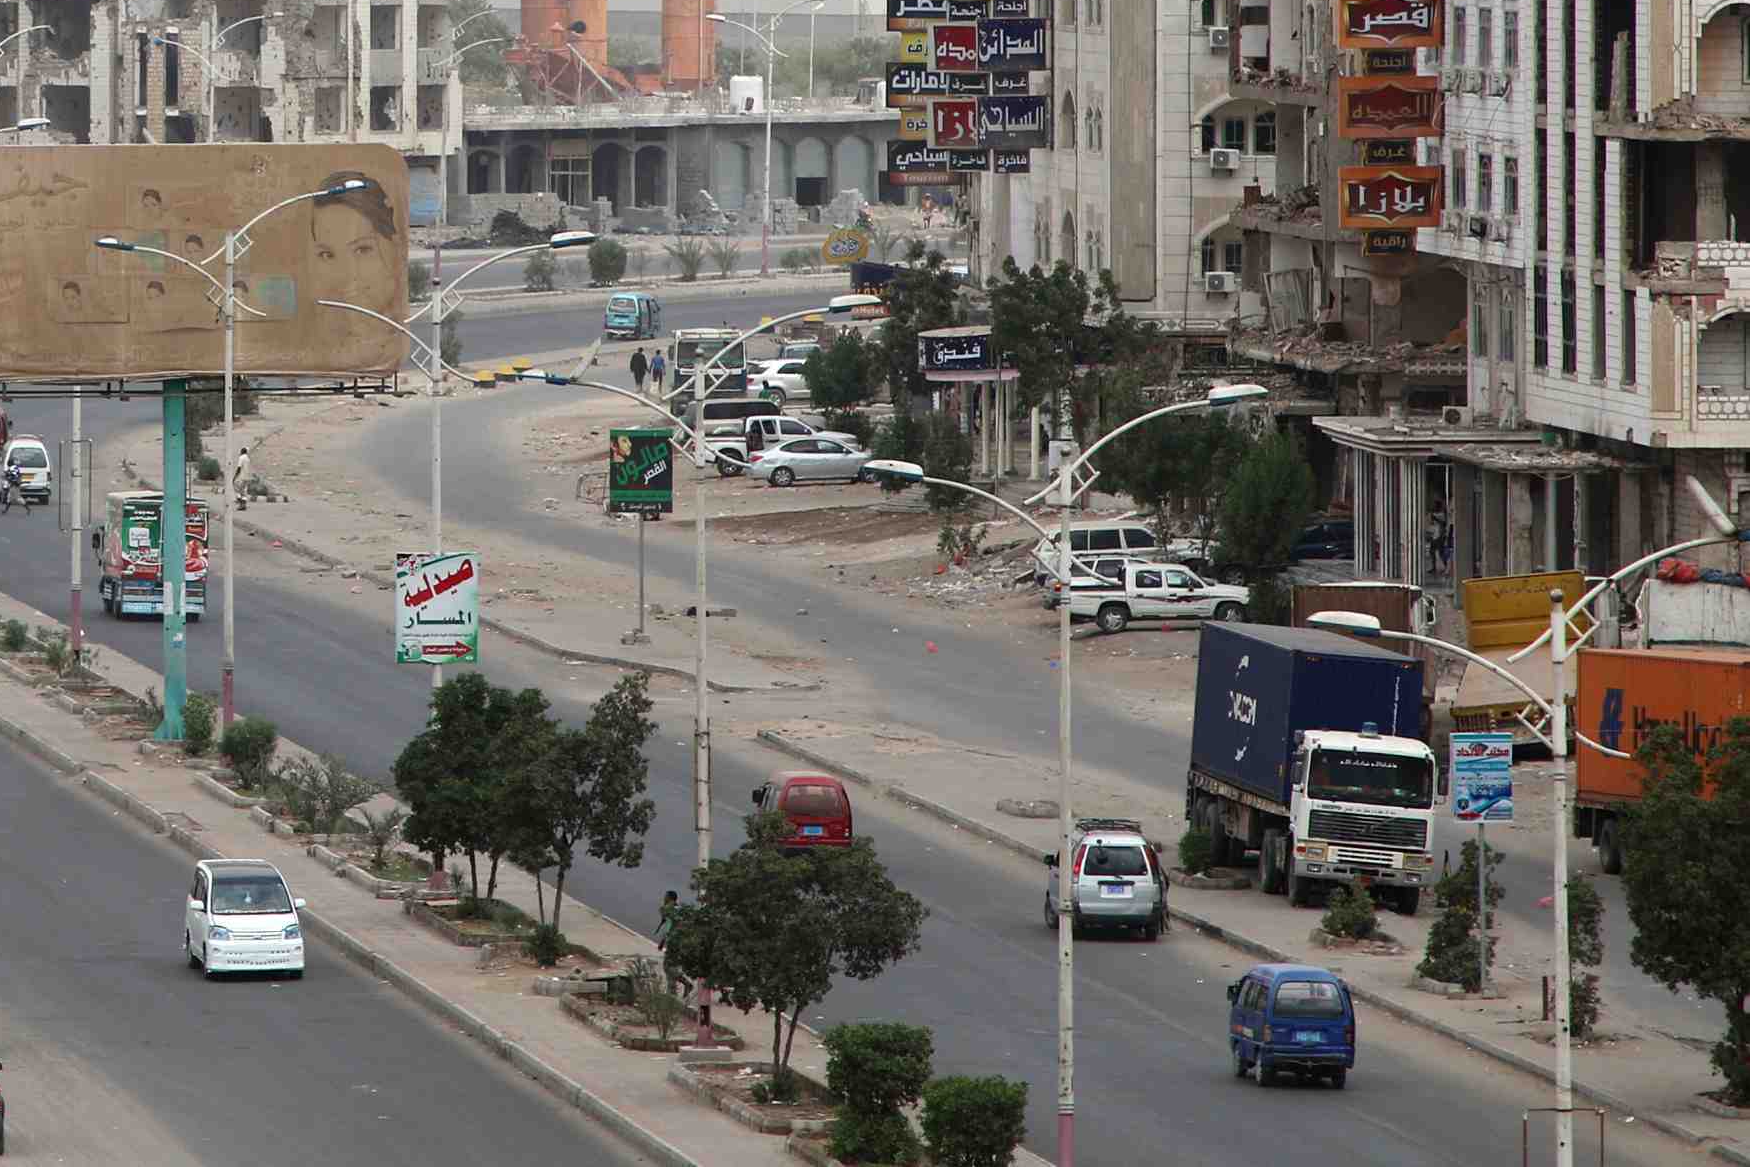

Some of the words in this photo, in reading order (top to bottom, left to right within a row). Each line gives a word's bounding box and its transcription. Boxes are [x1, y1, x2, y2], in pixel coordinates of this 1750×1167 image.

[1350, 2, 1429, 33] قصر
[1358, 184, 1426, 214] بلازا
[932, 341, 982, 365] فندق
[643, 459, 668, 486] القصر
[399, 558, 475, 611] صيدلية
[402, 610, 472, 629] المسار
